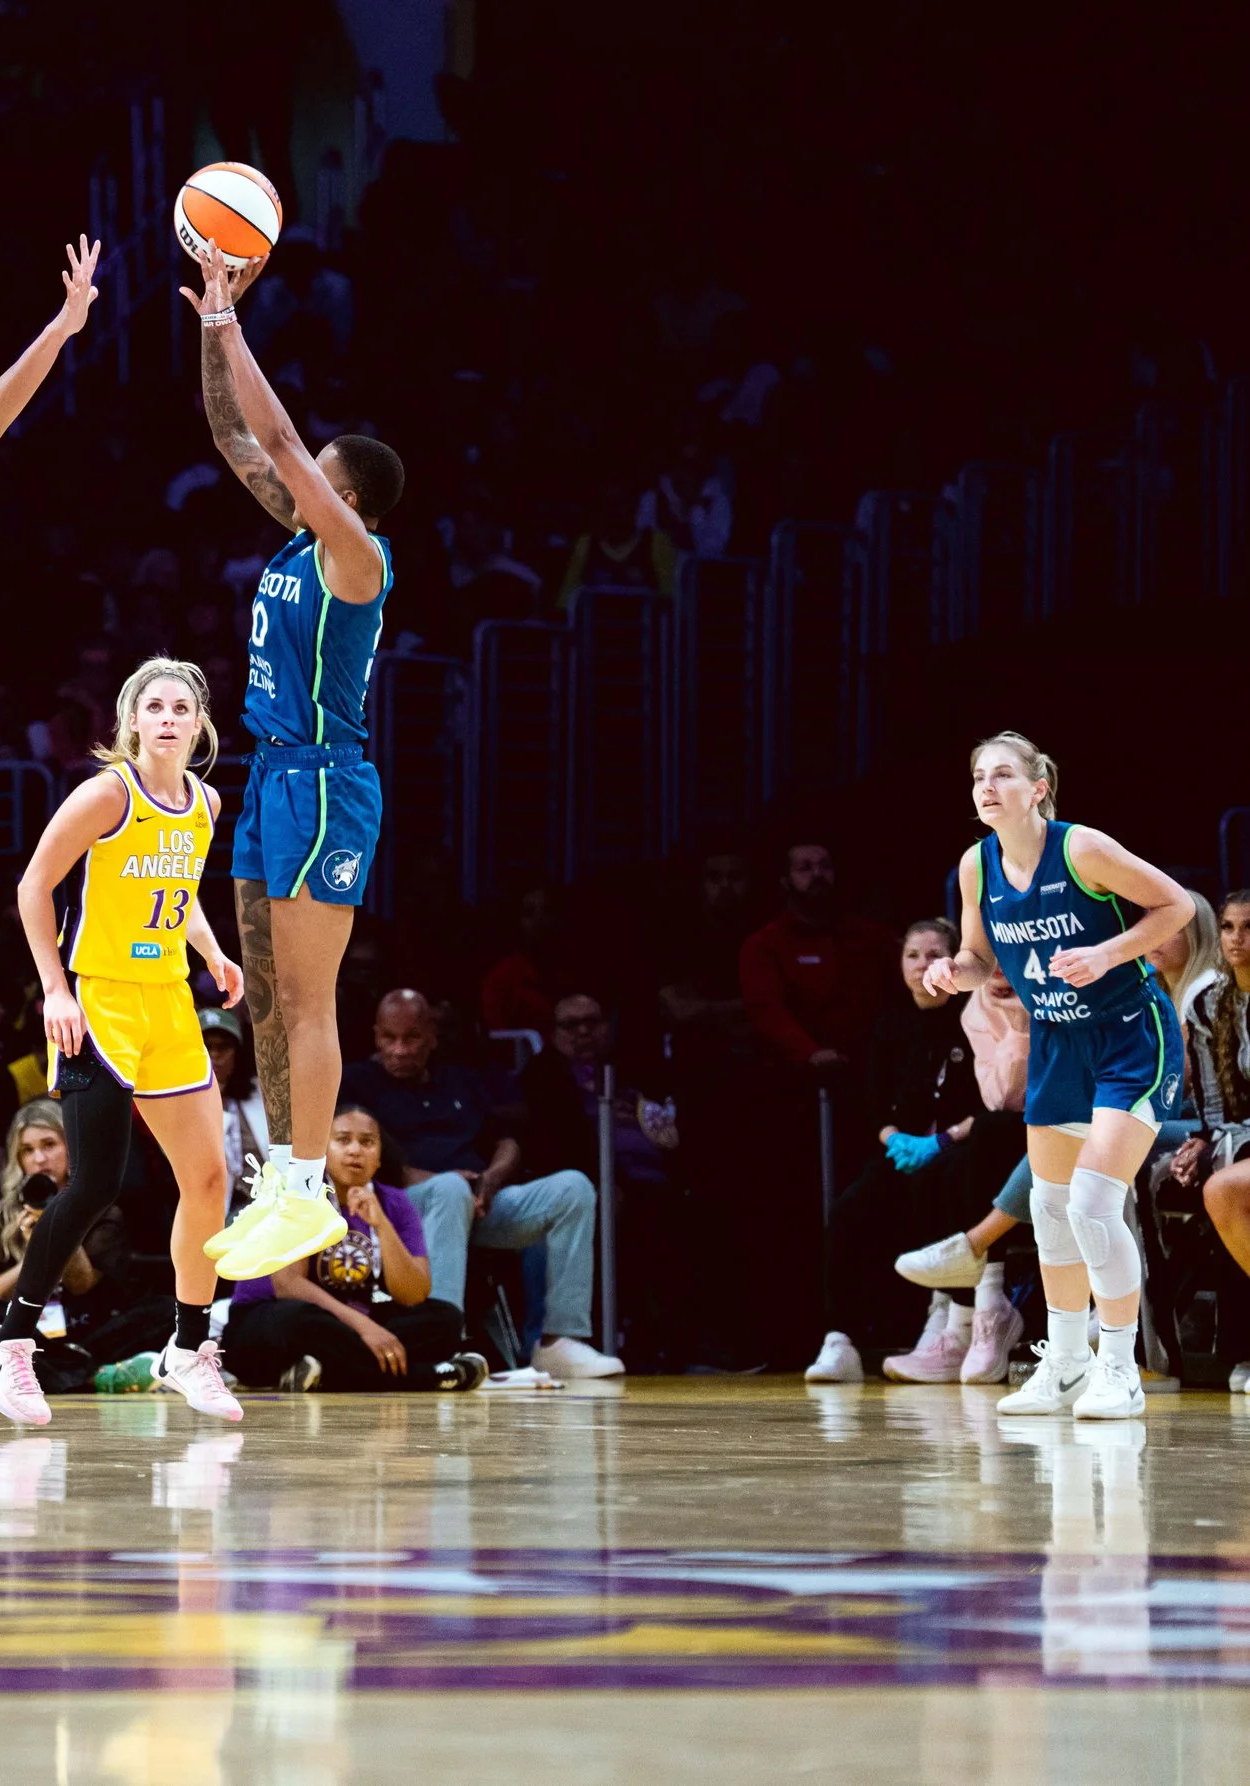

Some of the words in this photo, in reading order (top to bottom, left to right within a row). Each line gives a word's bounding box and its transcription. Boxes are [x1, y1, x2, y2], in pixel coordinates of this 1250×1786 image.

[158, 829, 195, 854] LOS
[120, 854, 206, 881] ANGELE
[143, 888, 190, 930] 13
[990, 911, 1085, 944] MINNESOTA
[135, 946, 158, 956] UCLA
[1031, 991, 1078, 1007] MAYO
